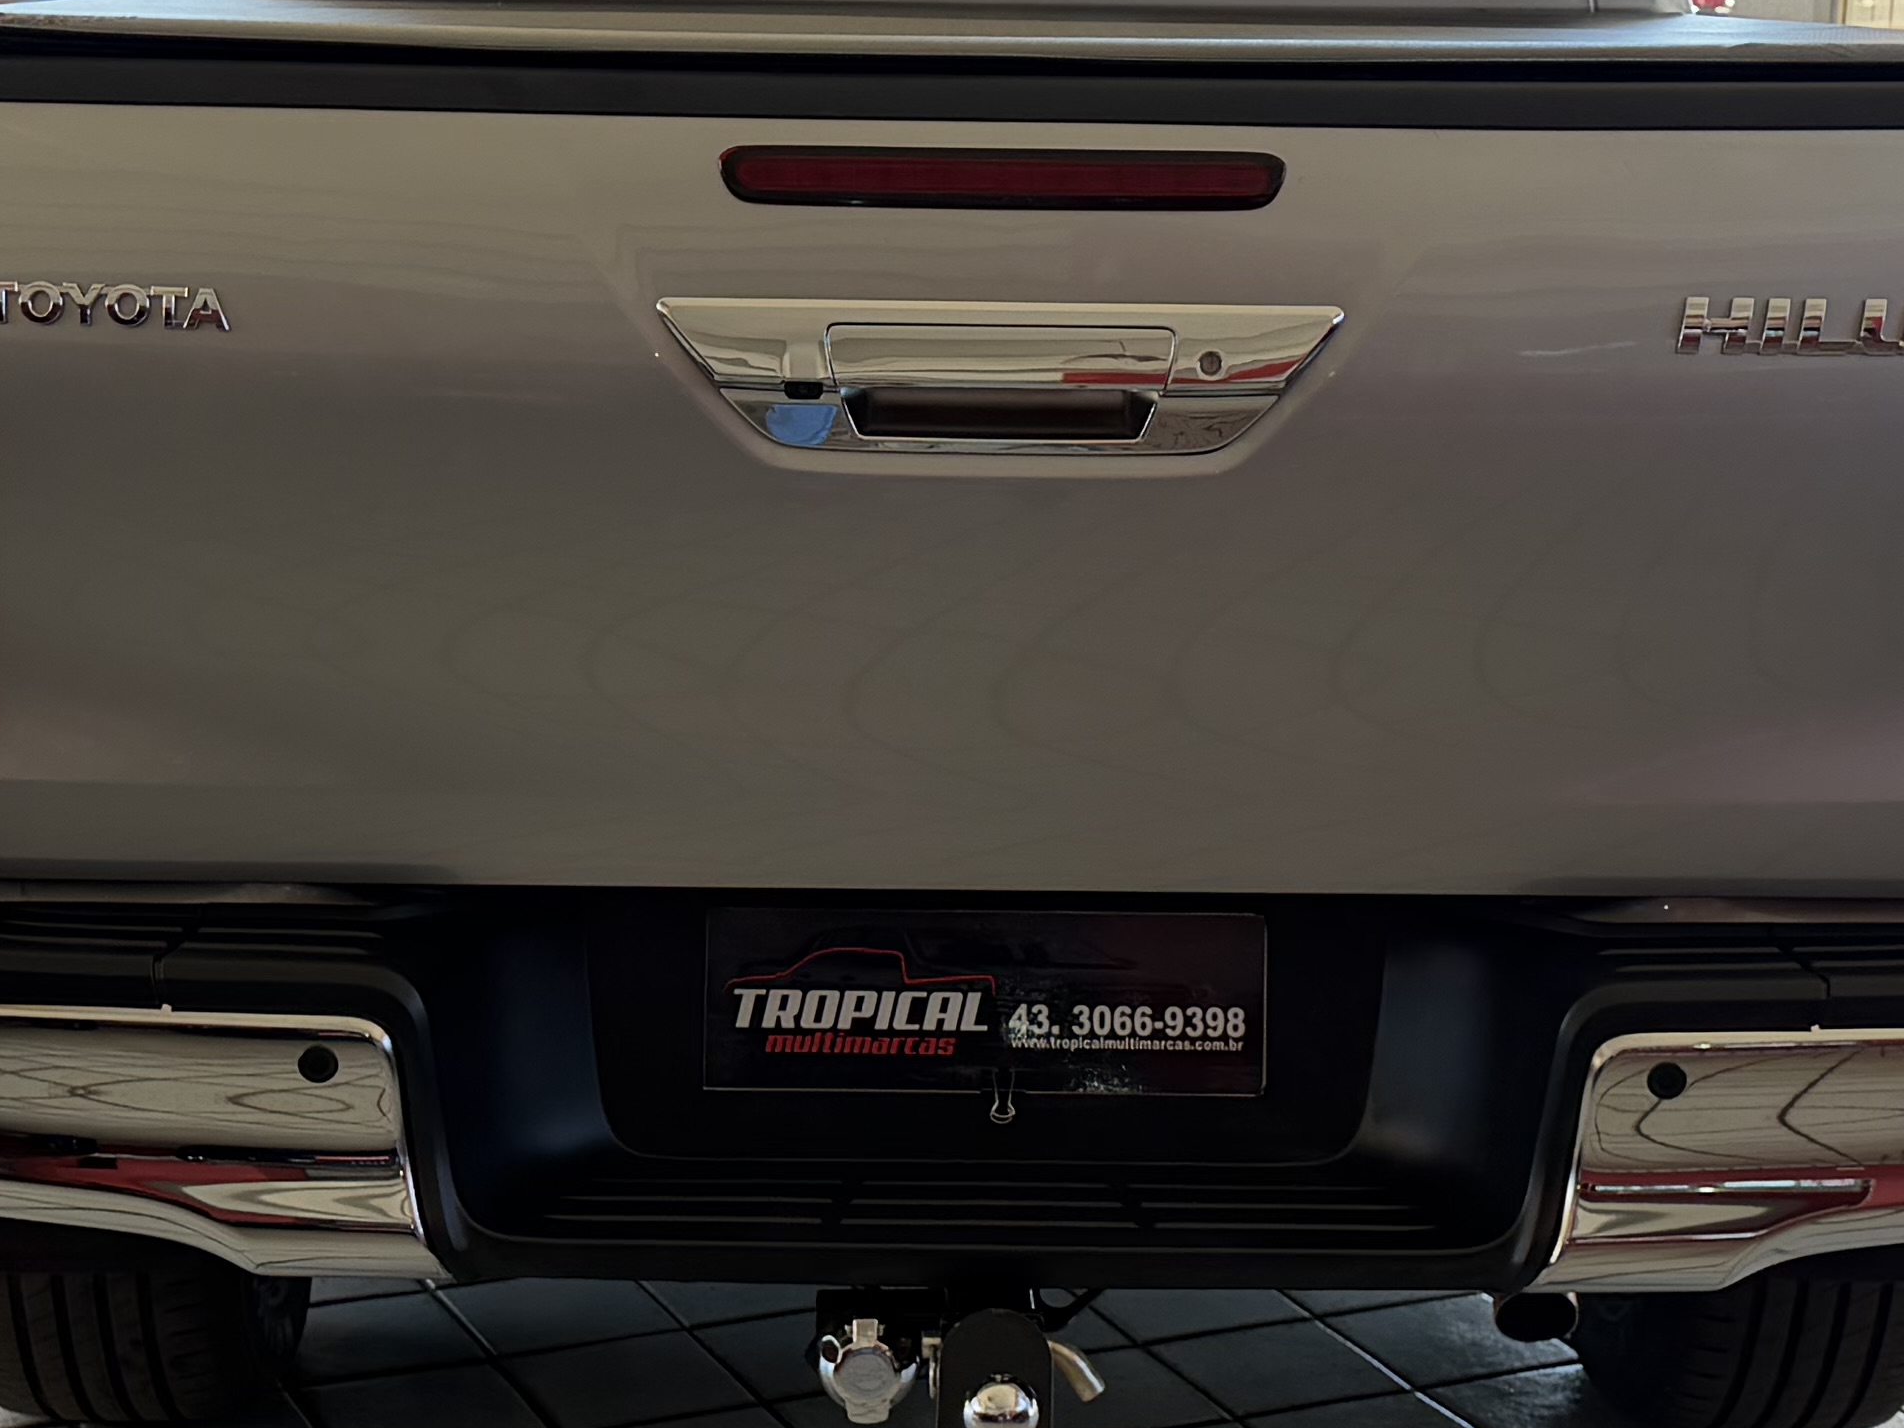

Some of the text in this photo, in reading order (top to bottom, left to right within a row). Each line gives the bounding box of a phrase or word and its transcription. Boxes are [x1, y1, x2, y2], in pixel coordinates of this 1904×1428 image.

[733, 988, 989, 1031] TROPICAL
[1008, 1003, 1247, 1038] 43. 3066-9398
[764, 1031, 957, 1056] multimarcas
[1010, 1036, 1244, 1052] www.tropicalmultimarcas.com.br
